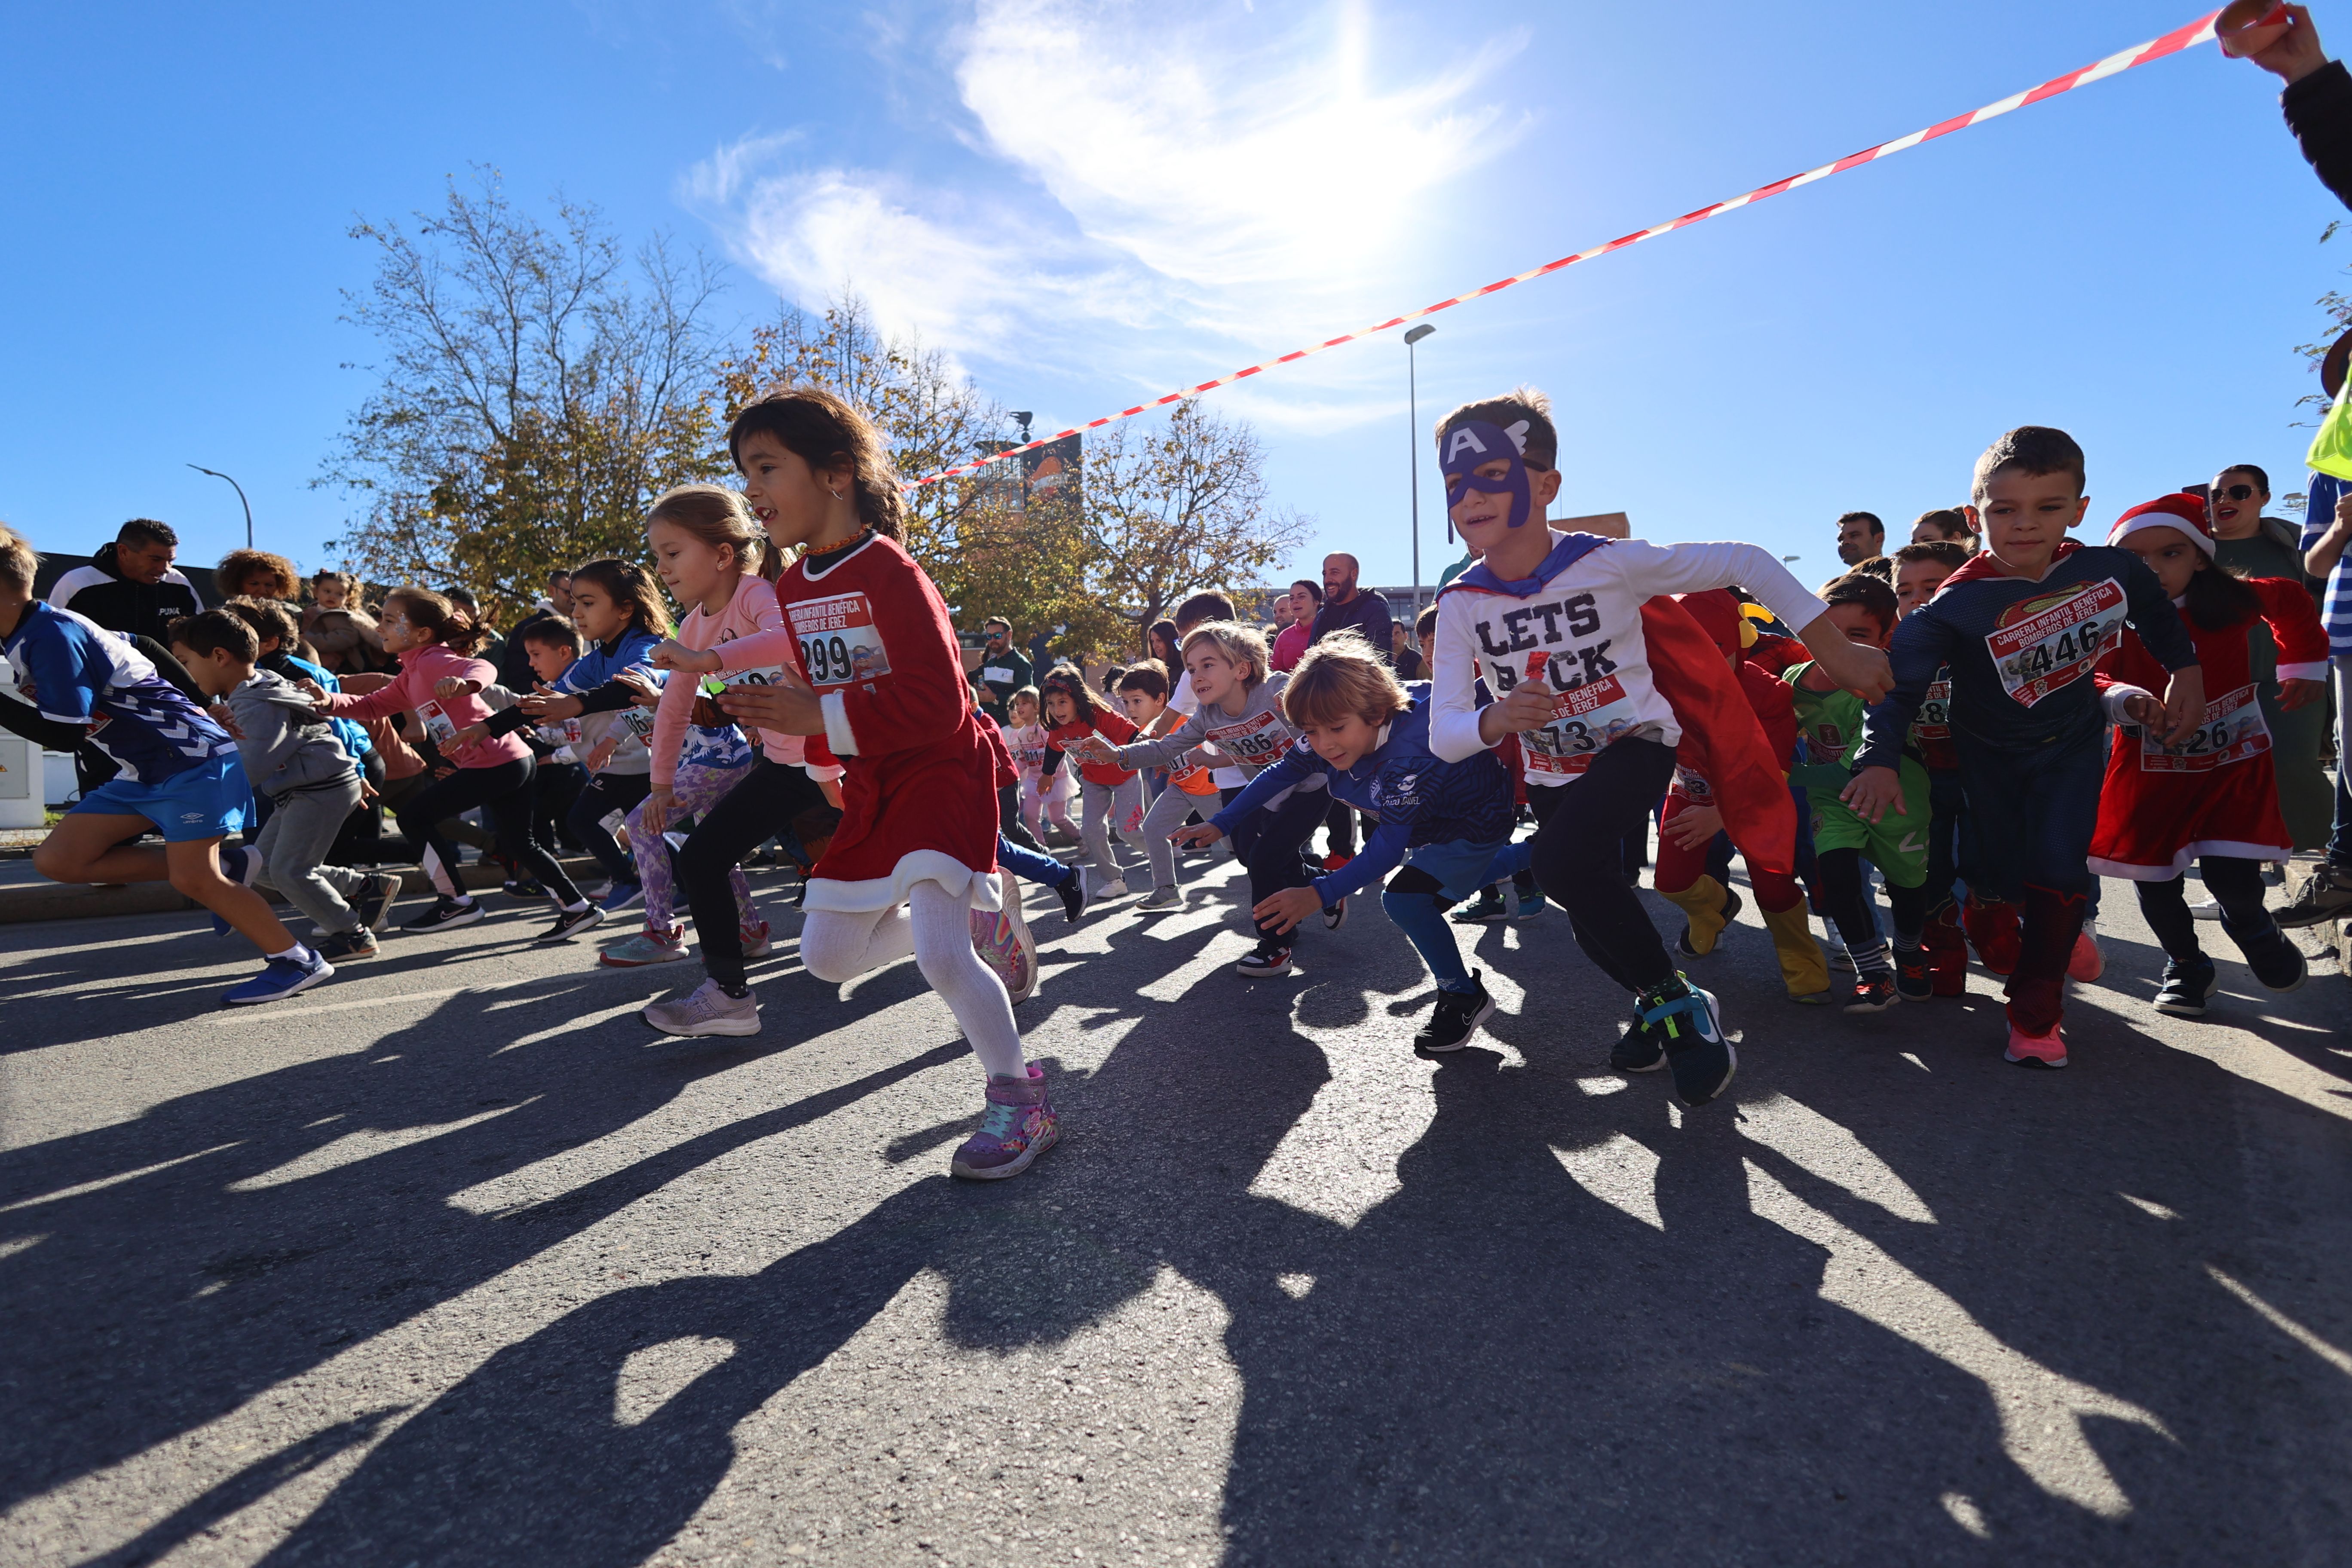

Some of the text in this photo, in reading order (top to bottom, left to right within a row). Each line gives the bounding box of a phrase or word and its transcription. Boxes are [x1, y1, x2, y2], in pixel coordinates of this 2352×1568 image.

[1447, 427, 1487, 464] A
[159, 607, 180, 616] PUMA
[802, 605, 827, 620] INFANTIL
[828, 600, 861, 616] BENÉFICA
[1997, 586, 2113, 646] CARRERA INFANTIL BENÉFICA
[820, 618, 827, 630] DE
[828, 615, 847, 629] JEREZ
[1476, 593, 1601, 657] LETS
[2018, 603, 2100, 648] BOMBEROS DE JEREZ
[2032, 622, 2100, 672] 446
[1568, 679, 1613, 704] BENÉFICA
[2222, 689, 2249, 708] BENÉFICA
[1558, 706, 1572, 717] DE
[1571, 696, 1600, 714] JEREZ
[2212, 711, 2221, 721] DE
[2221, 702, 2239, 717] JEREZ
[1227, 724, 1246, 734] INFANTIL
[1246, 714, 1268, 730] BENÉFICA
[1250, 723, 1263, 734] JEREZ
[1231, 733, 1273, 756] 186
[1540, 721, 1596, 754] 73
